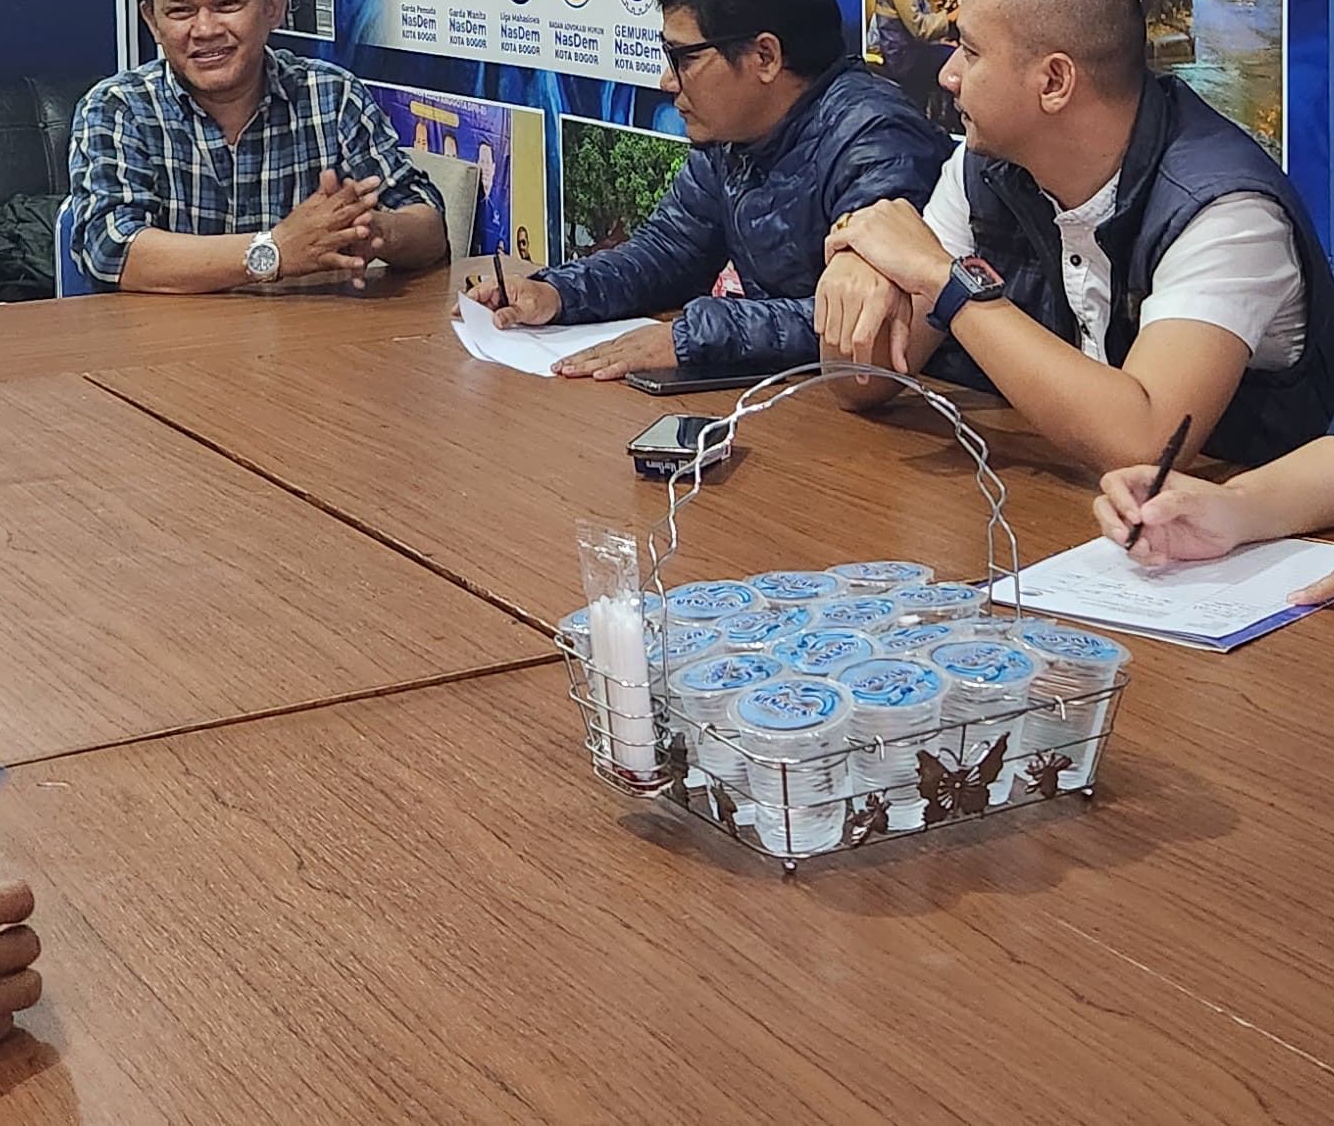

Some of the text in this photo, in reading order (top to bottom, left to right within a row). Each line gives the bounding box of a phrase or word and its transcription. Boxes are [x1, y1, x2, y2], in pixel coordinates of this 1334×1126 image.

[402, 13, 436, 30] NasDem
[449, 18, 487, 35] NasDem
[402, 30, 437, 42] KOTA BOGOR
[500, 24, 540, 42] NasDem
[555, 31, 598, 50] NasDem
[614, 25, 661, 42] GEMURUH
[449, 36, 487, 48] KOTA BOGOR
[501, 42, 540, 55] KOTA BOGOR
[614, 39, 661, 60] NasDem
[555, 50, 598, 64] KOTA BOGOR
[614, 58, 661, 74] KOTA BOGOR
